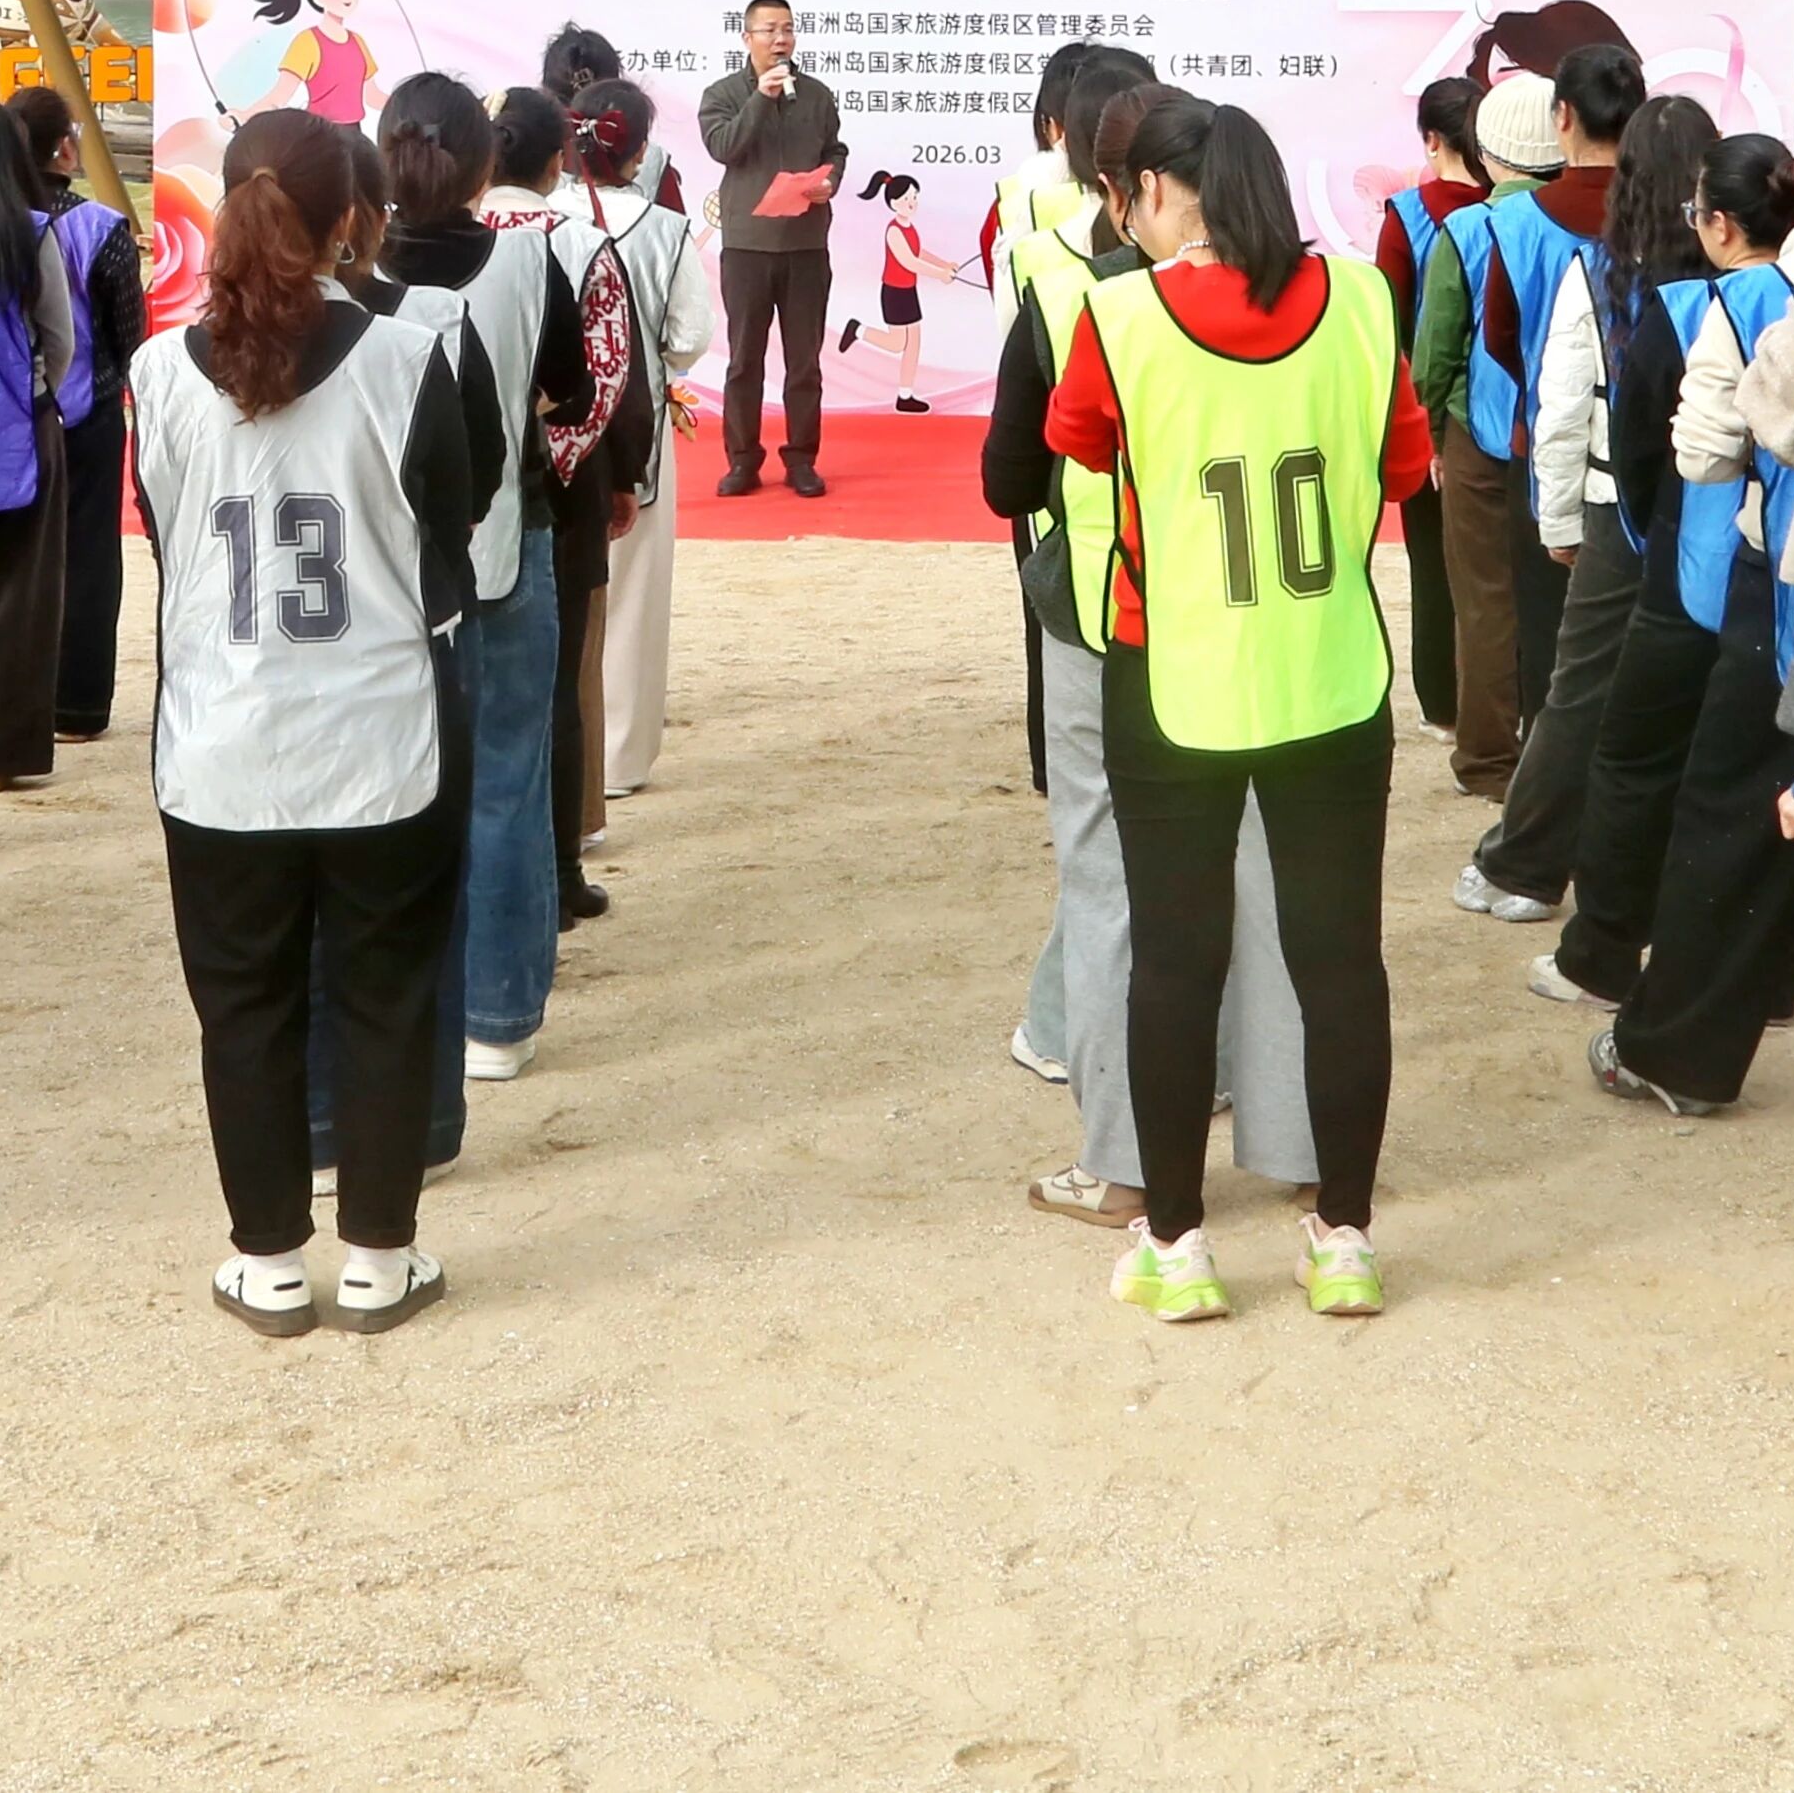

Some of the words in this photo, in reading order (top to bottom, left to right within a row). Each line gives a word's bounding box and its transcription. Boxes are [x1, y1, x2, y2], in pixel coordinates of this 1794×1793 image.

[911, 144, 1001, 165] 2026.03
[210, 492, 351, 645] 13
[1199, 446, 1336, 607] 10
